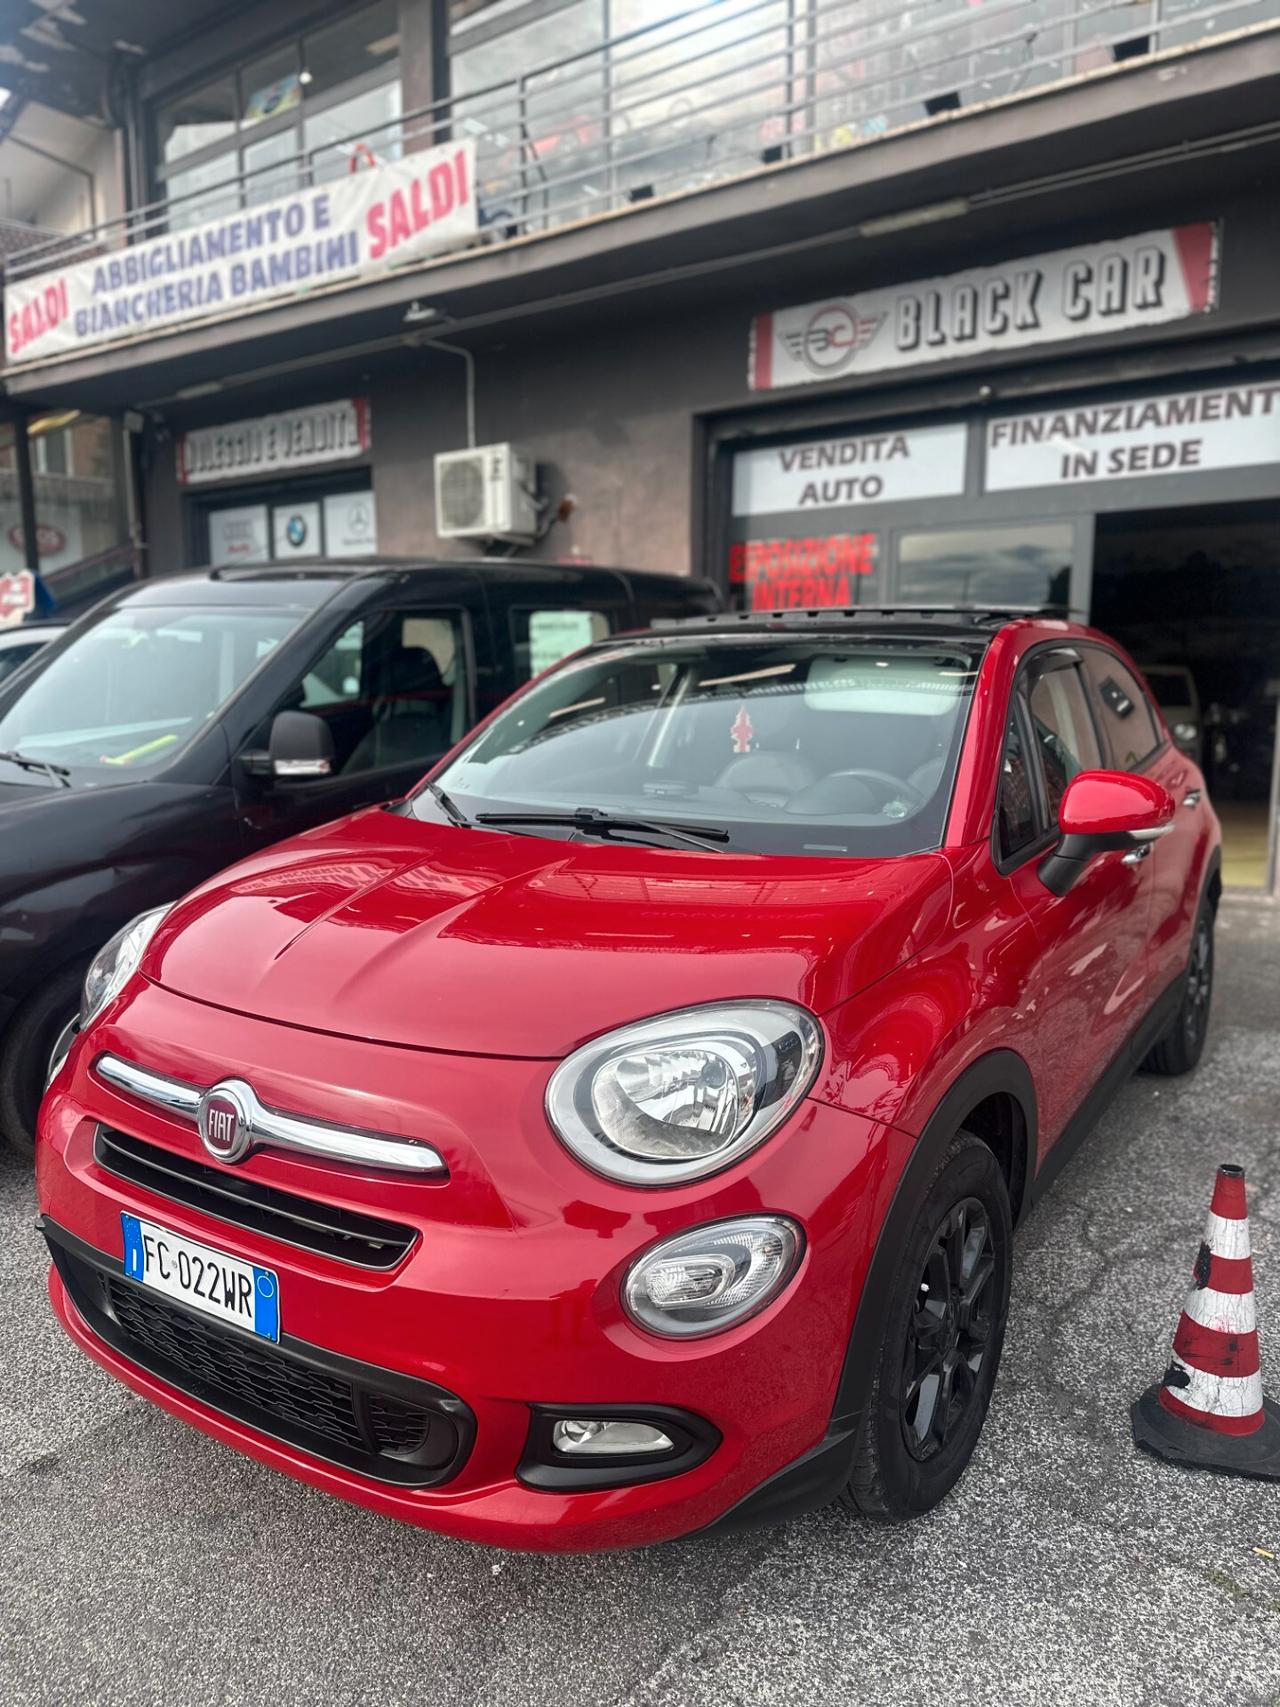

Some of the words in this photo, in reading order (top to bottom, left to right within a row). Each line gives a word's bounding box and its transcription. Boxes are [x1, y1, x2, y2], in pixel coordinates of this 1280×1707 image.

[367, 148, 470, 260] SALDI
[92, 204, 305, 295] ABBIGLIAMENTO
[313, 194, 331, 230] E
[8, 277, 69, 355] SALDI
[75, 271, 223, 338] BIANCHERIA
[230, 231, 359, 296] BAMBINI
[896, 269, 1043, 353] BLACK
[1063, 245, 1167, 322] CAR
[778, 434, 911, 473] VENDITA
[990, 386, 1280, 448] FINANZIAMENT
[797, 474, 883, 506] AUTO
[1060, 448, 1100, 480] IN
[1105, 438, 1203, 475] SEDE
[208, 1109, 235, 1142] FIAT
[143, 1234, 171, 1280] FC
[177, 1250, 253, 1318] 022WR
